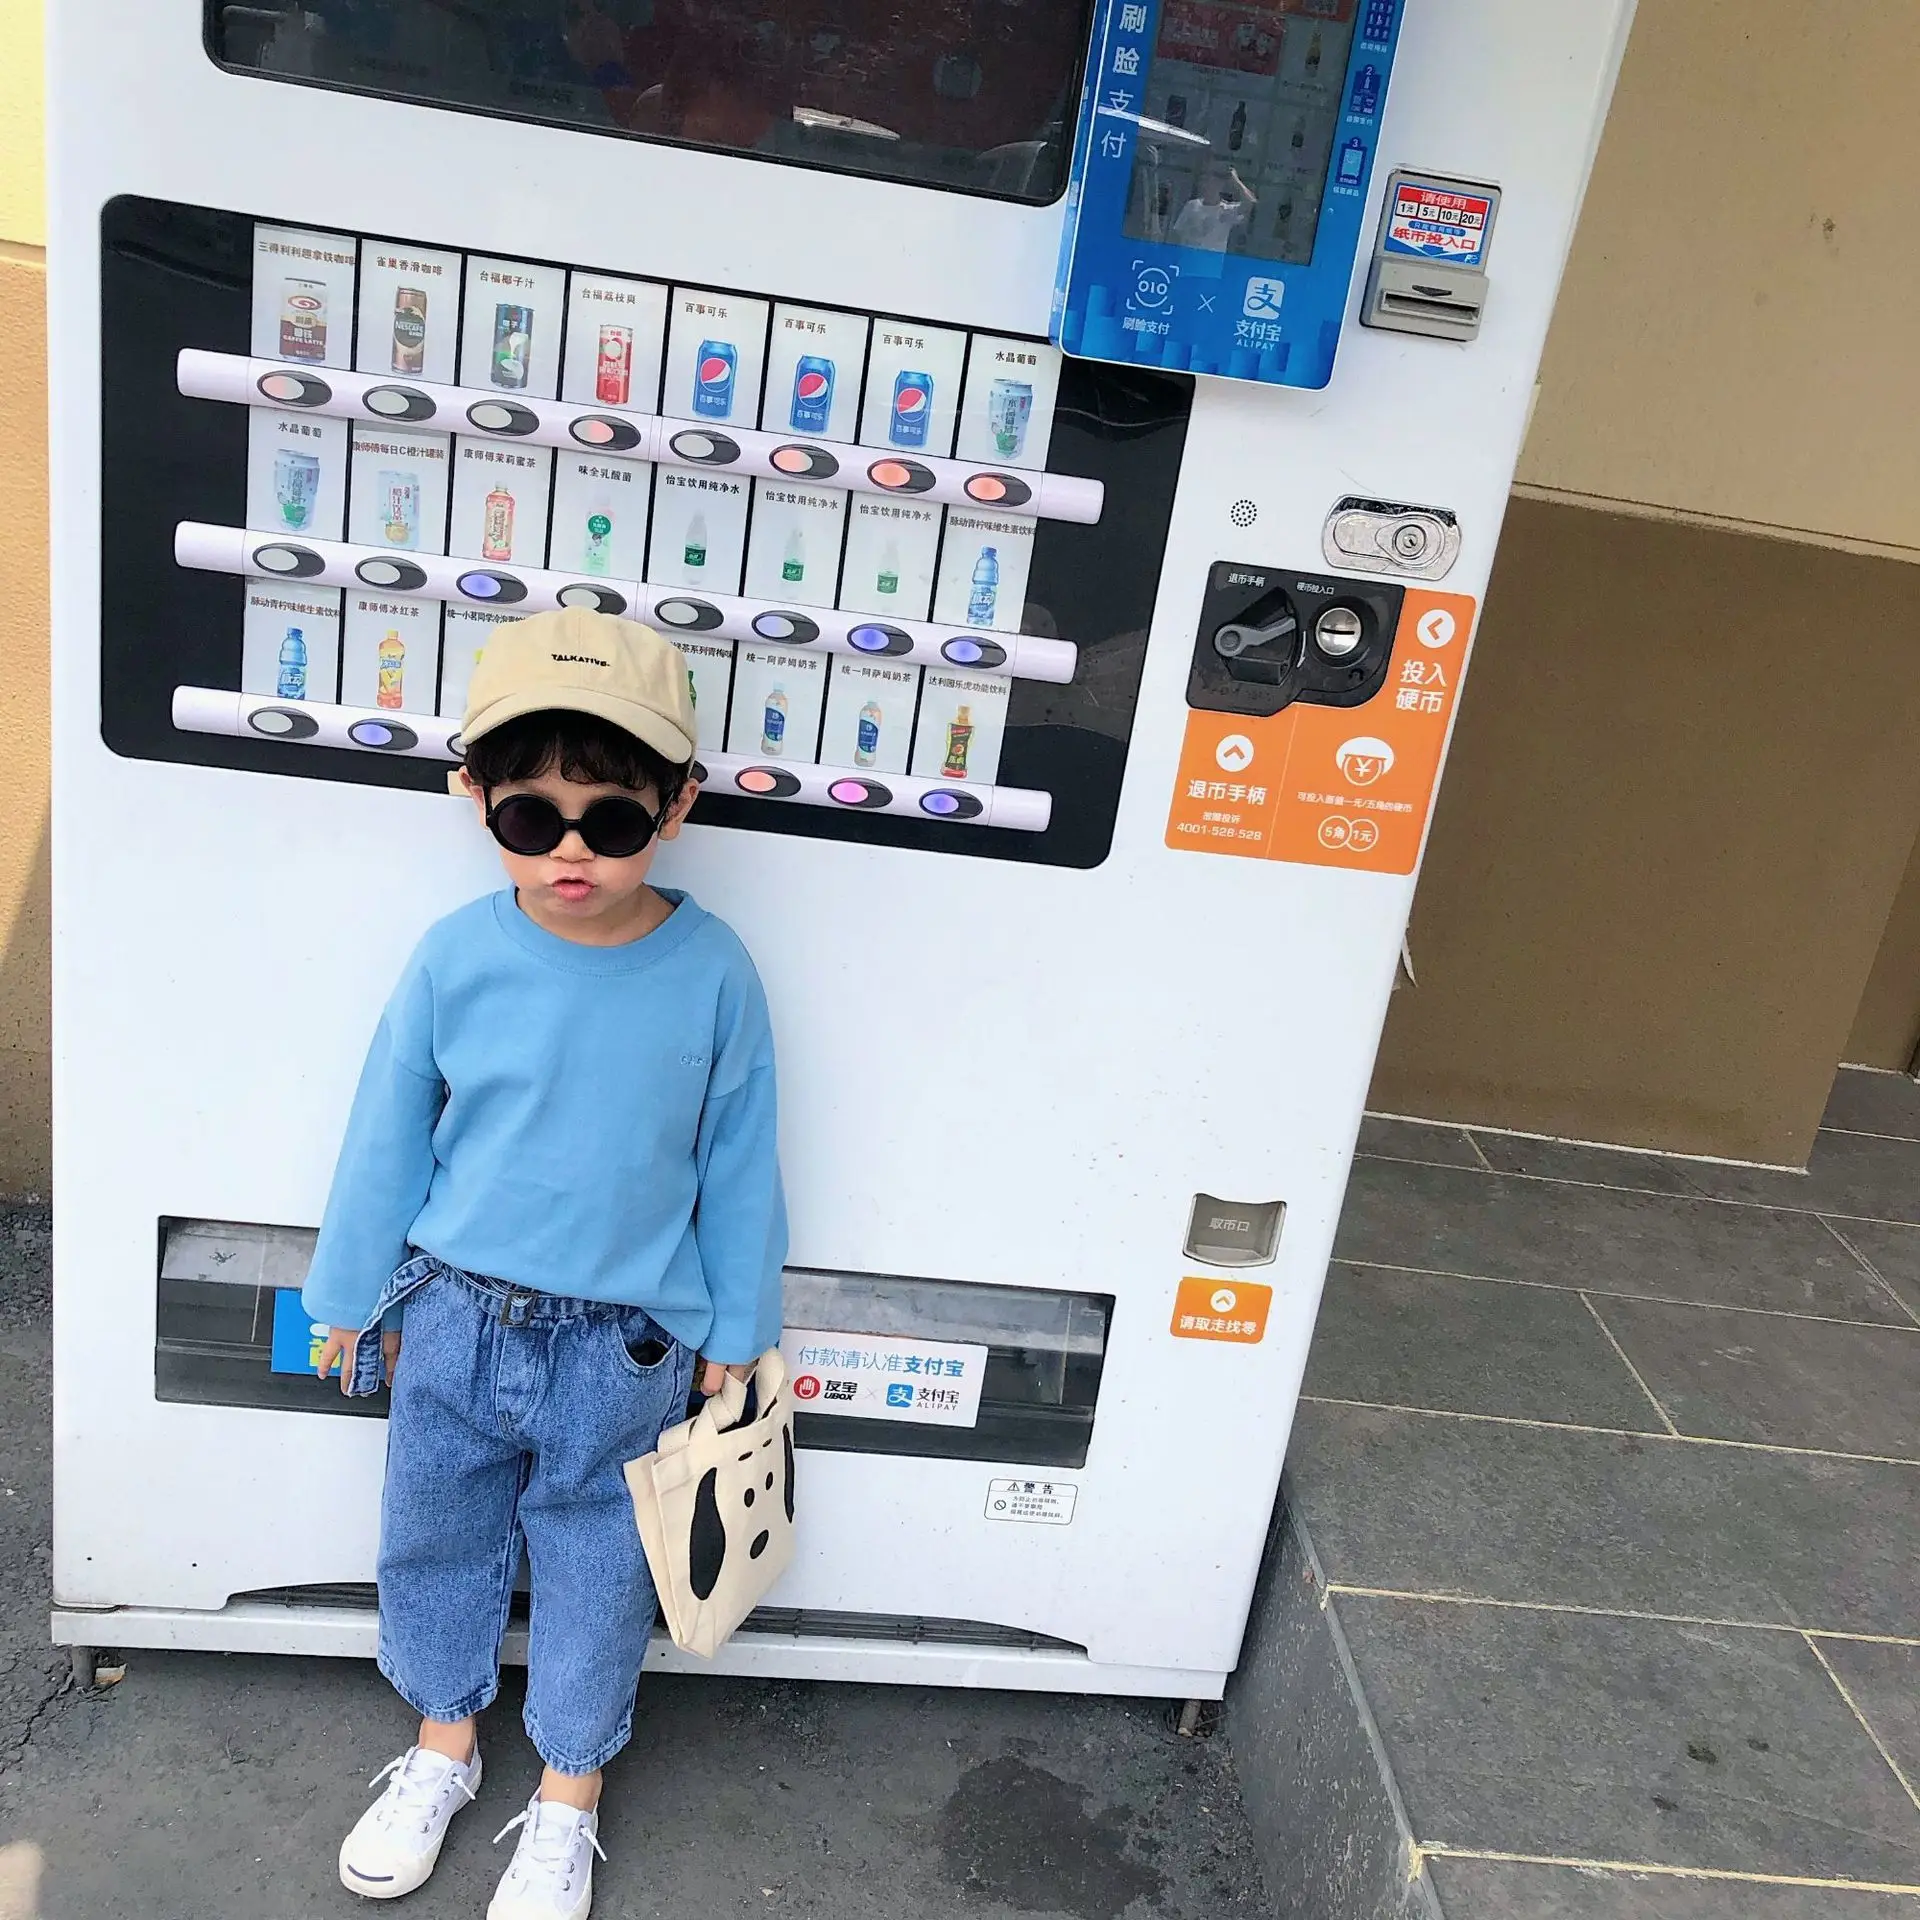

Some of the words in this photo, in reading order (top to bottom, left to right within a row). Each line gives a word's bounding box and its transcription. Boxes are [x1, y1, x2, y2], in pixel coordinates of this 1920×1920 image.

[1101, 3, 1148, 159] 刷脸支付
[1420, 191, 1467, 209] 请使用
[1393, 226, 1476, 251] 纸币投入口
[376, 256, 443, 276] 雀巢香滑咖啡
[479, 270, 535, 289] 台福椰子汁
[685, 302, 728, 319] 百事可乐
[784, 318, 827, 334] 百事可乐
[1122, 317, 1170, 335] 刷脸支付
[1233, 319, 1282, 342] 支付宝
[882, 334, 925, 349] 百事可乐
[1236, 339, 1276, 351] ALIPAY
[995, 351, 1037, 366] 水晶葡萄
[278, 421, 322, 438] 水晶葡萄
[463, 448, 536, 468] 康师傅茉莉蜜茶
[578, 465, 632, 483] 味全乳酸菌
[666, 474, 740, 495] 怡宝饮用纯净水
[765, 490, 838, 510] 怡宝饮用纯净水
[859, 503, 932, 522] 怡宝饮用纯净水
[1228, 572, 1266, 588] 退币手柄
[358, 601, 419, 617] 康师傅冰红茶
[746, 652, 818, 670] 统一阿萨姆奶茶
[842, 664, 912, 683] 统一阿萨姆奶茶
[1400, 659, 1447, 688] 投入
[928, 675, 1007, 696] 达利园乐虎功能饮料
[1396, 687, 1445, 714] 硬币
[1187, 779, 1268, 806] 退币手柄
[1180, 1315, 1257, 1336] 请取走找零
[798, 1345, 965, 1378] 付款请认准支付宝
[824, 1379, 858, 1394] 友宝
[917, 1387, 960, 1404] 支付宝
[823, 1392, 854, 1401] UBOX
[916, 1401, 958, 1411] ALIPAY
